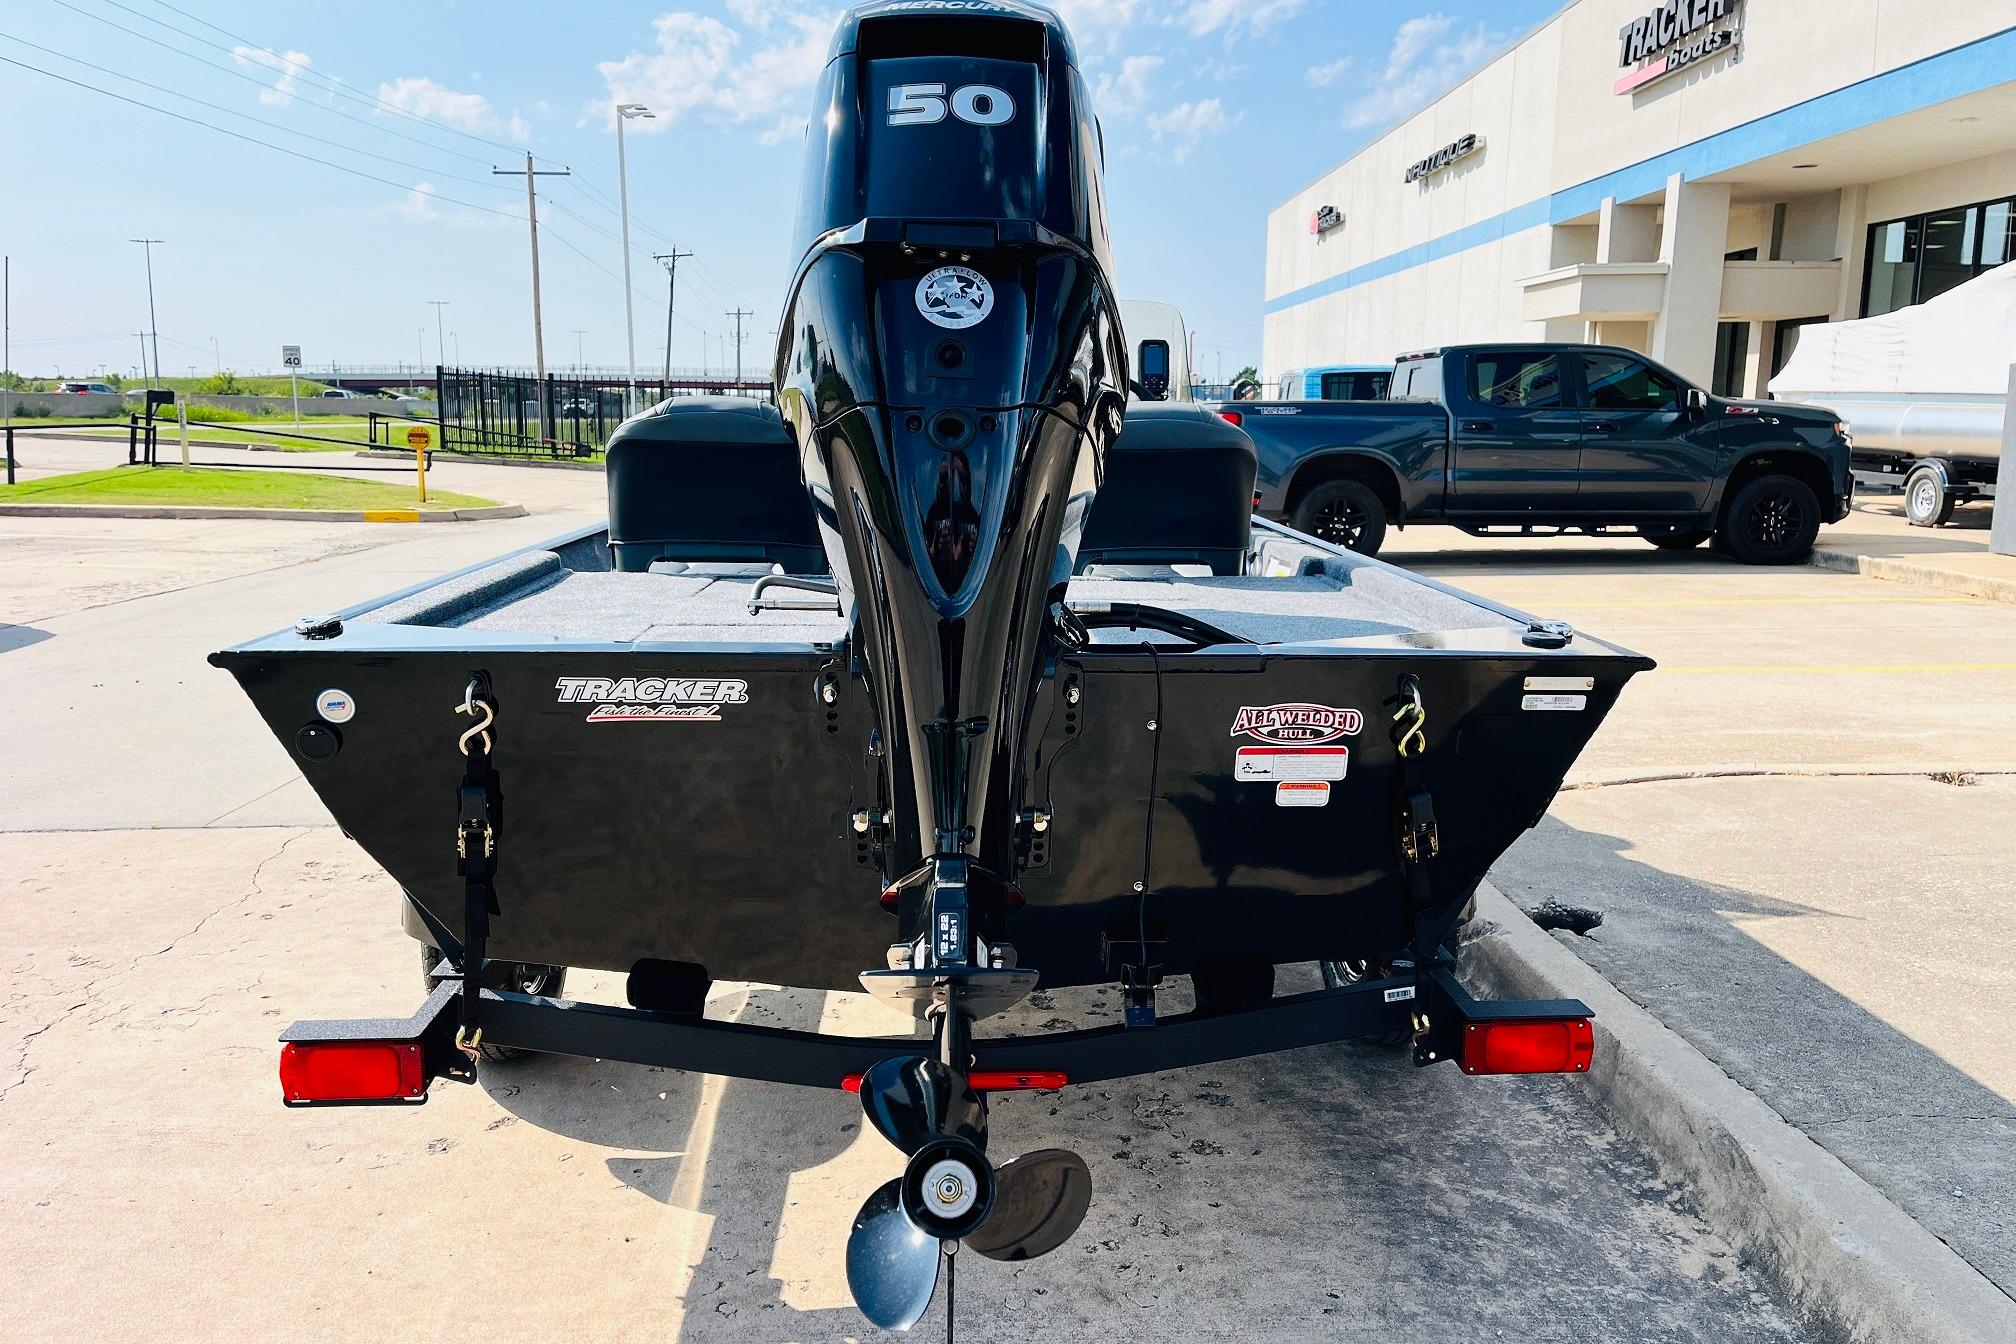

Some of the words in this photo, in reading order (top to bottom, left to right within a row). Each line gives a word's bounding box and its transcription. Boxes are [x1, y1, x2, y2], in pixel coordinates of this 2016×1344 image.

[1667, 31, 1722, 71] boats
[887, 83, 1016, 126] 50
[926, 267, 957, 281] ULTRA
[966, 270, 987, 285] LOW
[285, 357, 300, 366] 40
[595, 705, 627, 716] Fish
[628, 706, 654, 716] the
[1233, 708, 1276, 732] ALL
[1277, 708, 1360, 732] WELDED
[1278, 729, 1315, 739] HULL
